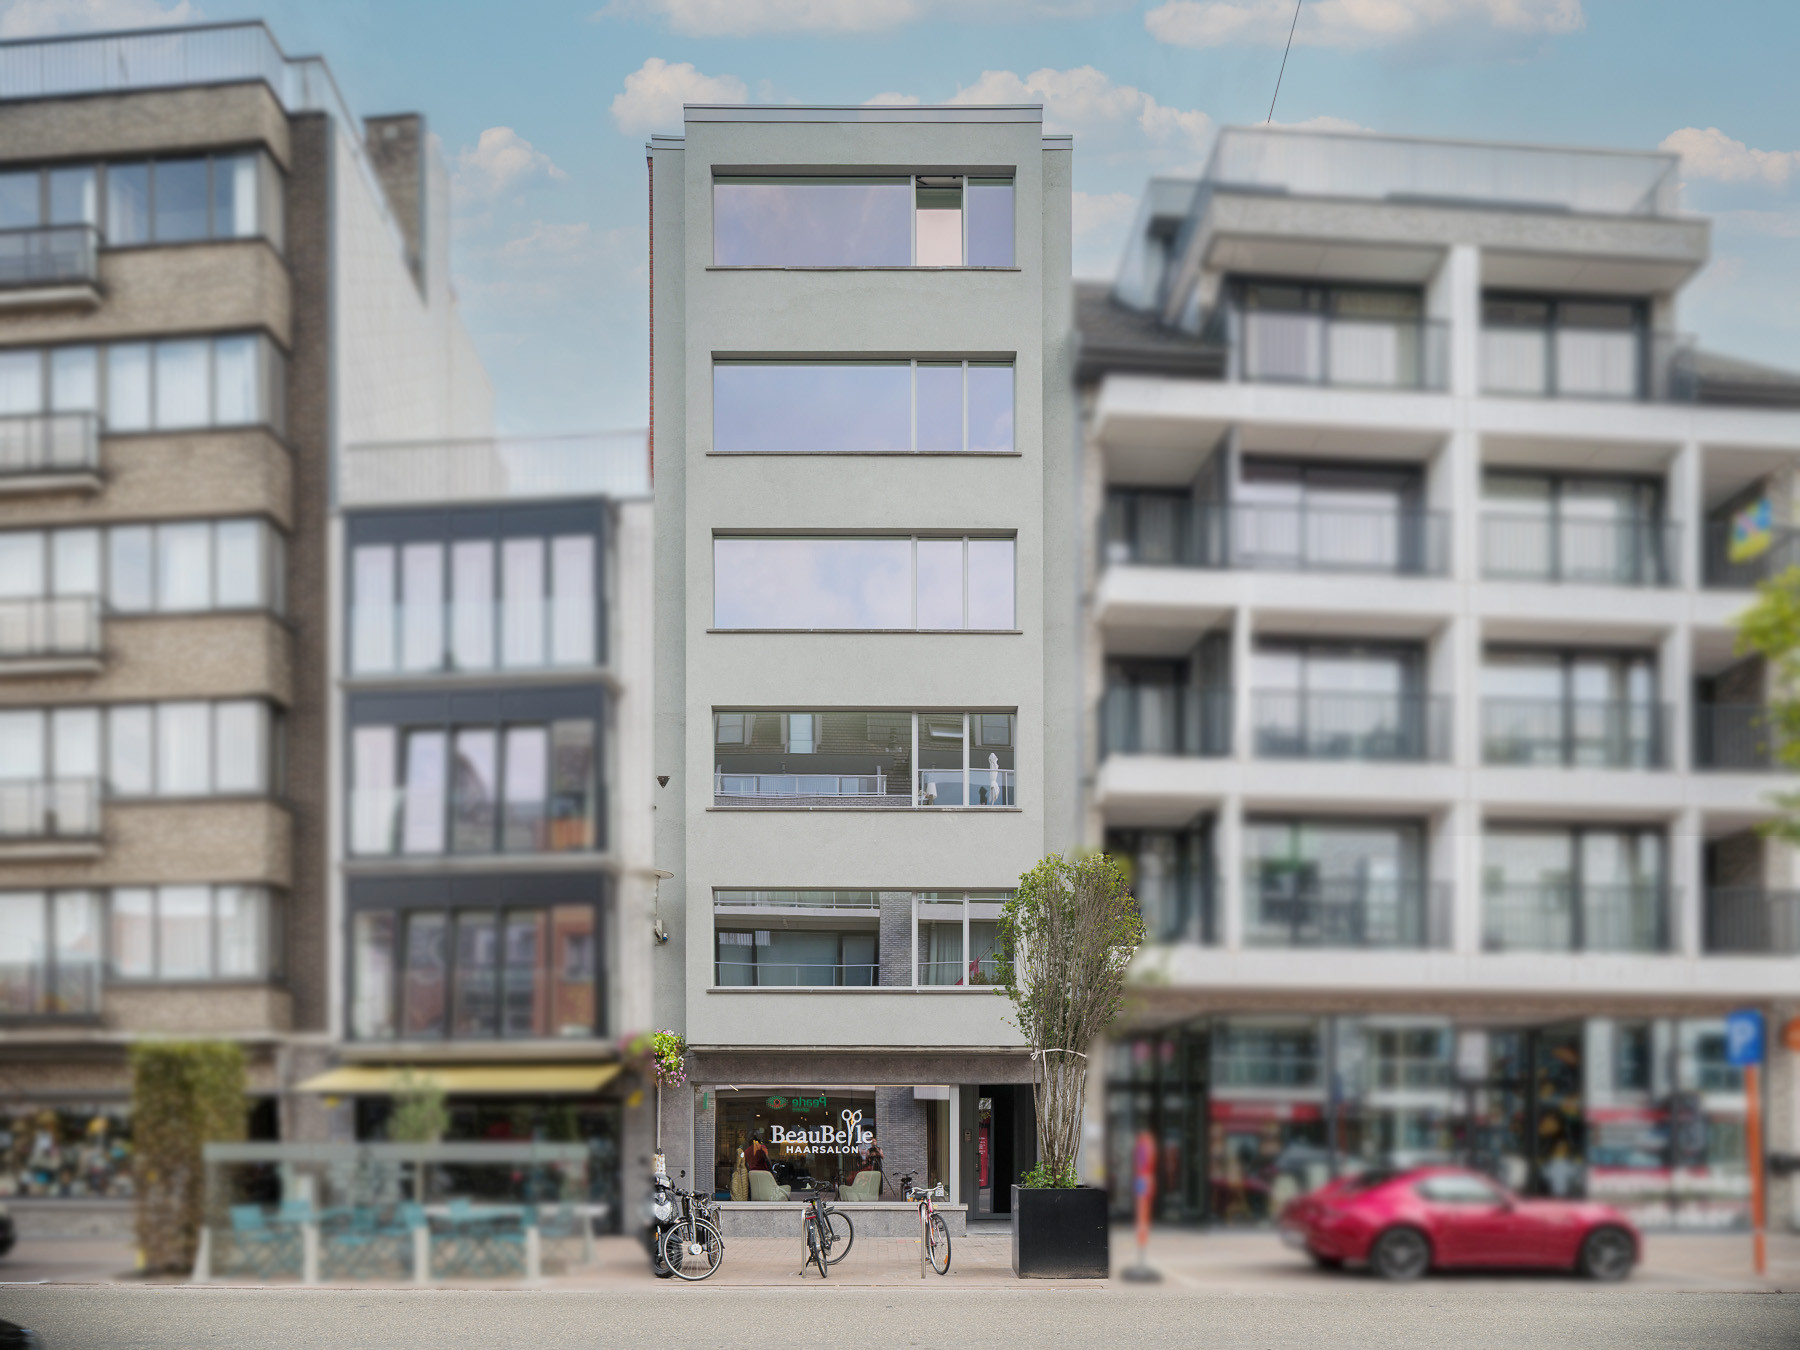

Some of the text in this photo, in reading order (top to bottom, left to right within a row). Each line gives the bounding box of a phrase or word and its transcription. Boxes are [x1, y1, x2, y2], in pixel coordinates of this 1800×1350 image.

[1730, 1019, 1756, 1058] P
[770, 1121, 874, 1146] BeauBelle
[786, 1145, 859, 1154] HAARSALON
